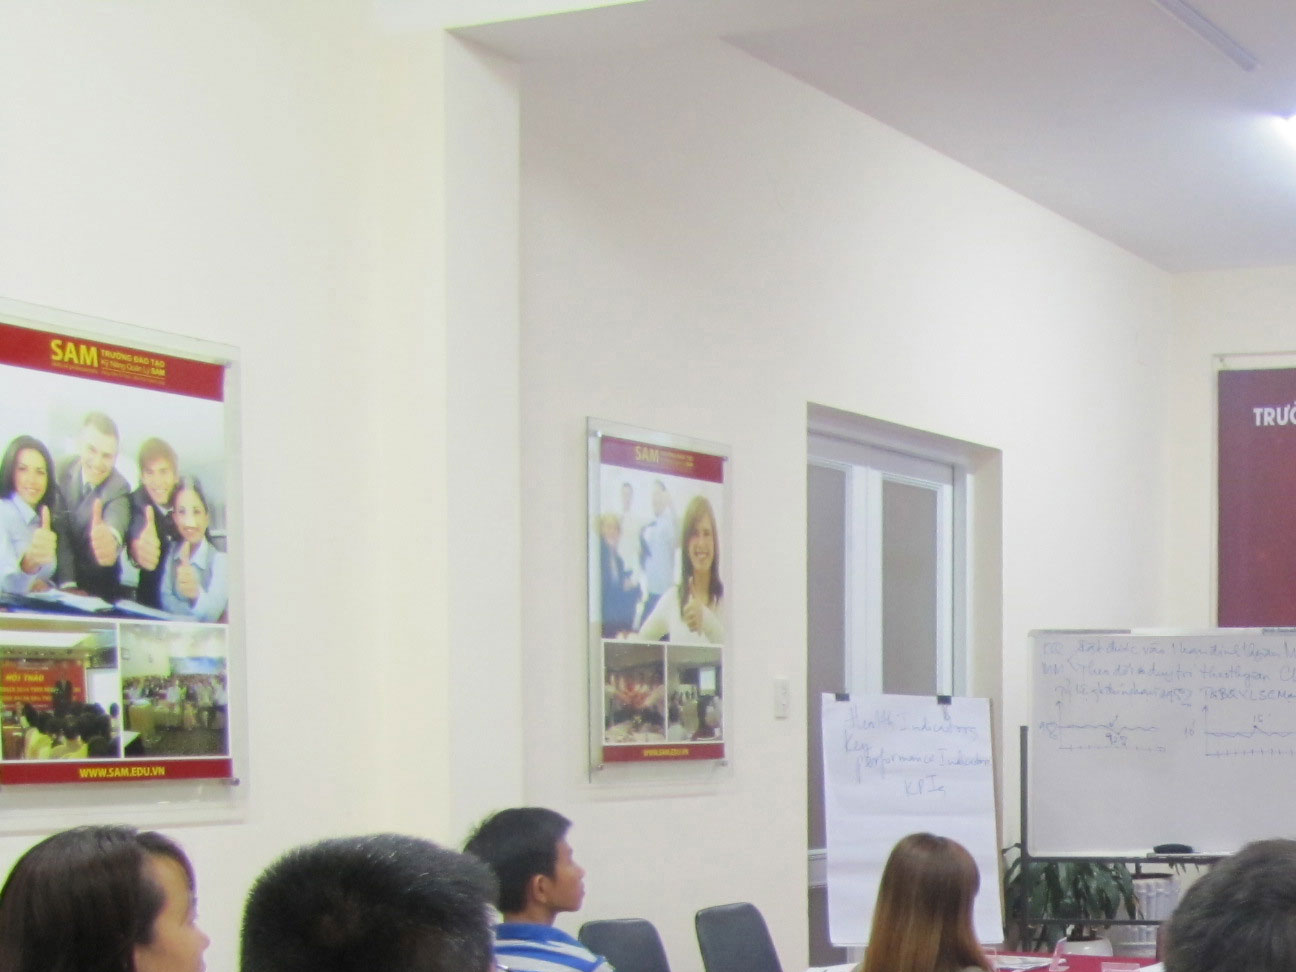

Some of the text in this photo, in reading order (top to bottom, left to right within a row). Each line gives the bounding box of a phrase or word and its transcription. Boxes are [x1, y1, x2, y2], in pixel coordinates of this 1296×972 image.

[50, 339, 98, 368] SAM
[636, 445, 659, 463] SAM
[79, 766, 165, 779] WWW.SAM.EDU.VN
